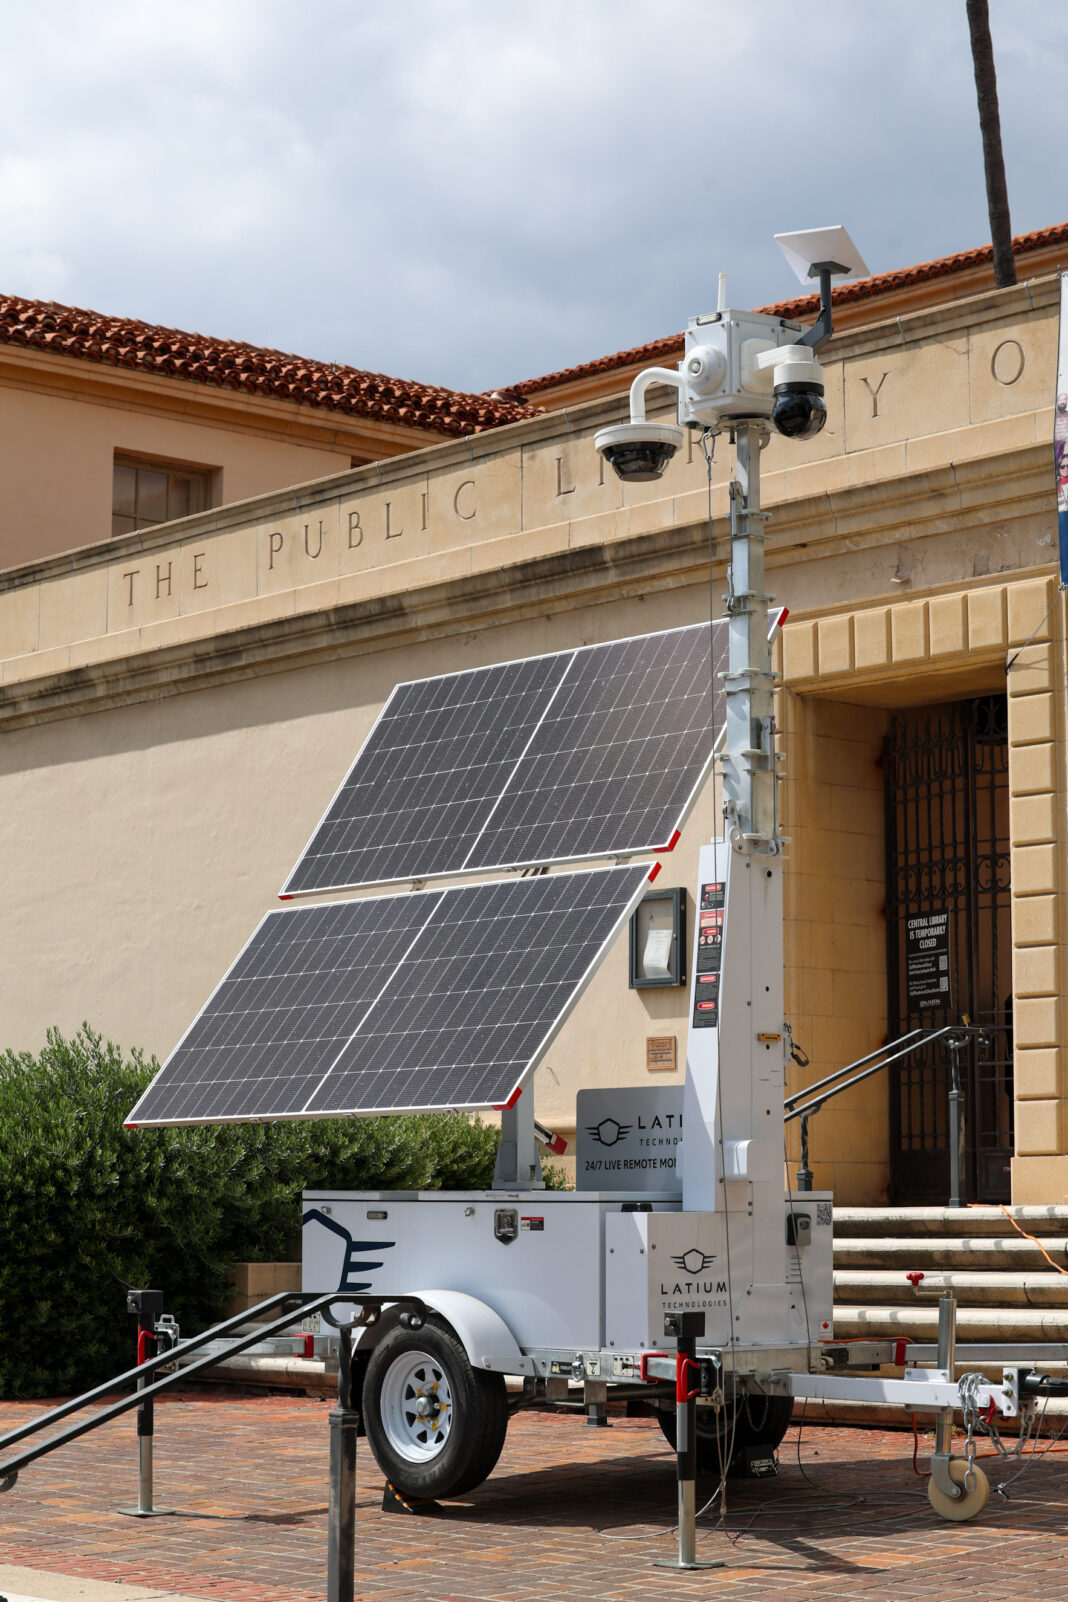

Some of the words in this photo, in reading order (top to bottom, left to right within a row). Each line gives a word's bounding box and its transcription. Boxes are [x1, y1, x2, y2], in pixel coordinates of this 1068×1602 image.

[123, 552, 208, 607] THE
[268, 480, 477, 570] PUBLIC
[908, 918, 928, 928] CENTRAL
[929, 914, 947, 925] LIBRARY
[910, 930, 915, 940] IS
[919, 938, 936, 948] CLOSED
[585, 1160, 602, 1172] 24/7
[604, 1159, 621, 1171] LIVE
[623, 1158, 657, 1170] REMOTE
[660, 1281, 727, 1295] LATIUM
[662, 1299, 728, 1309] TECHNOLOGIES
